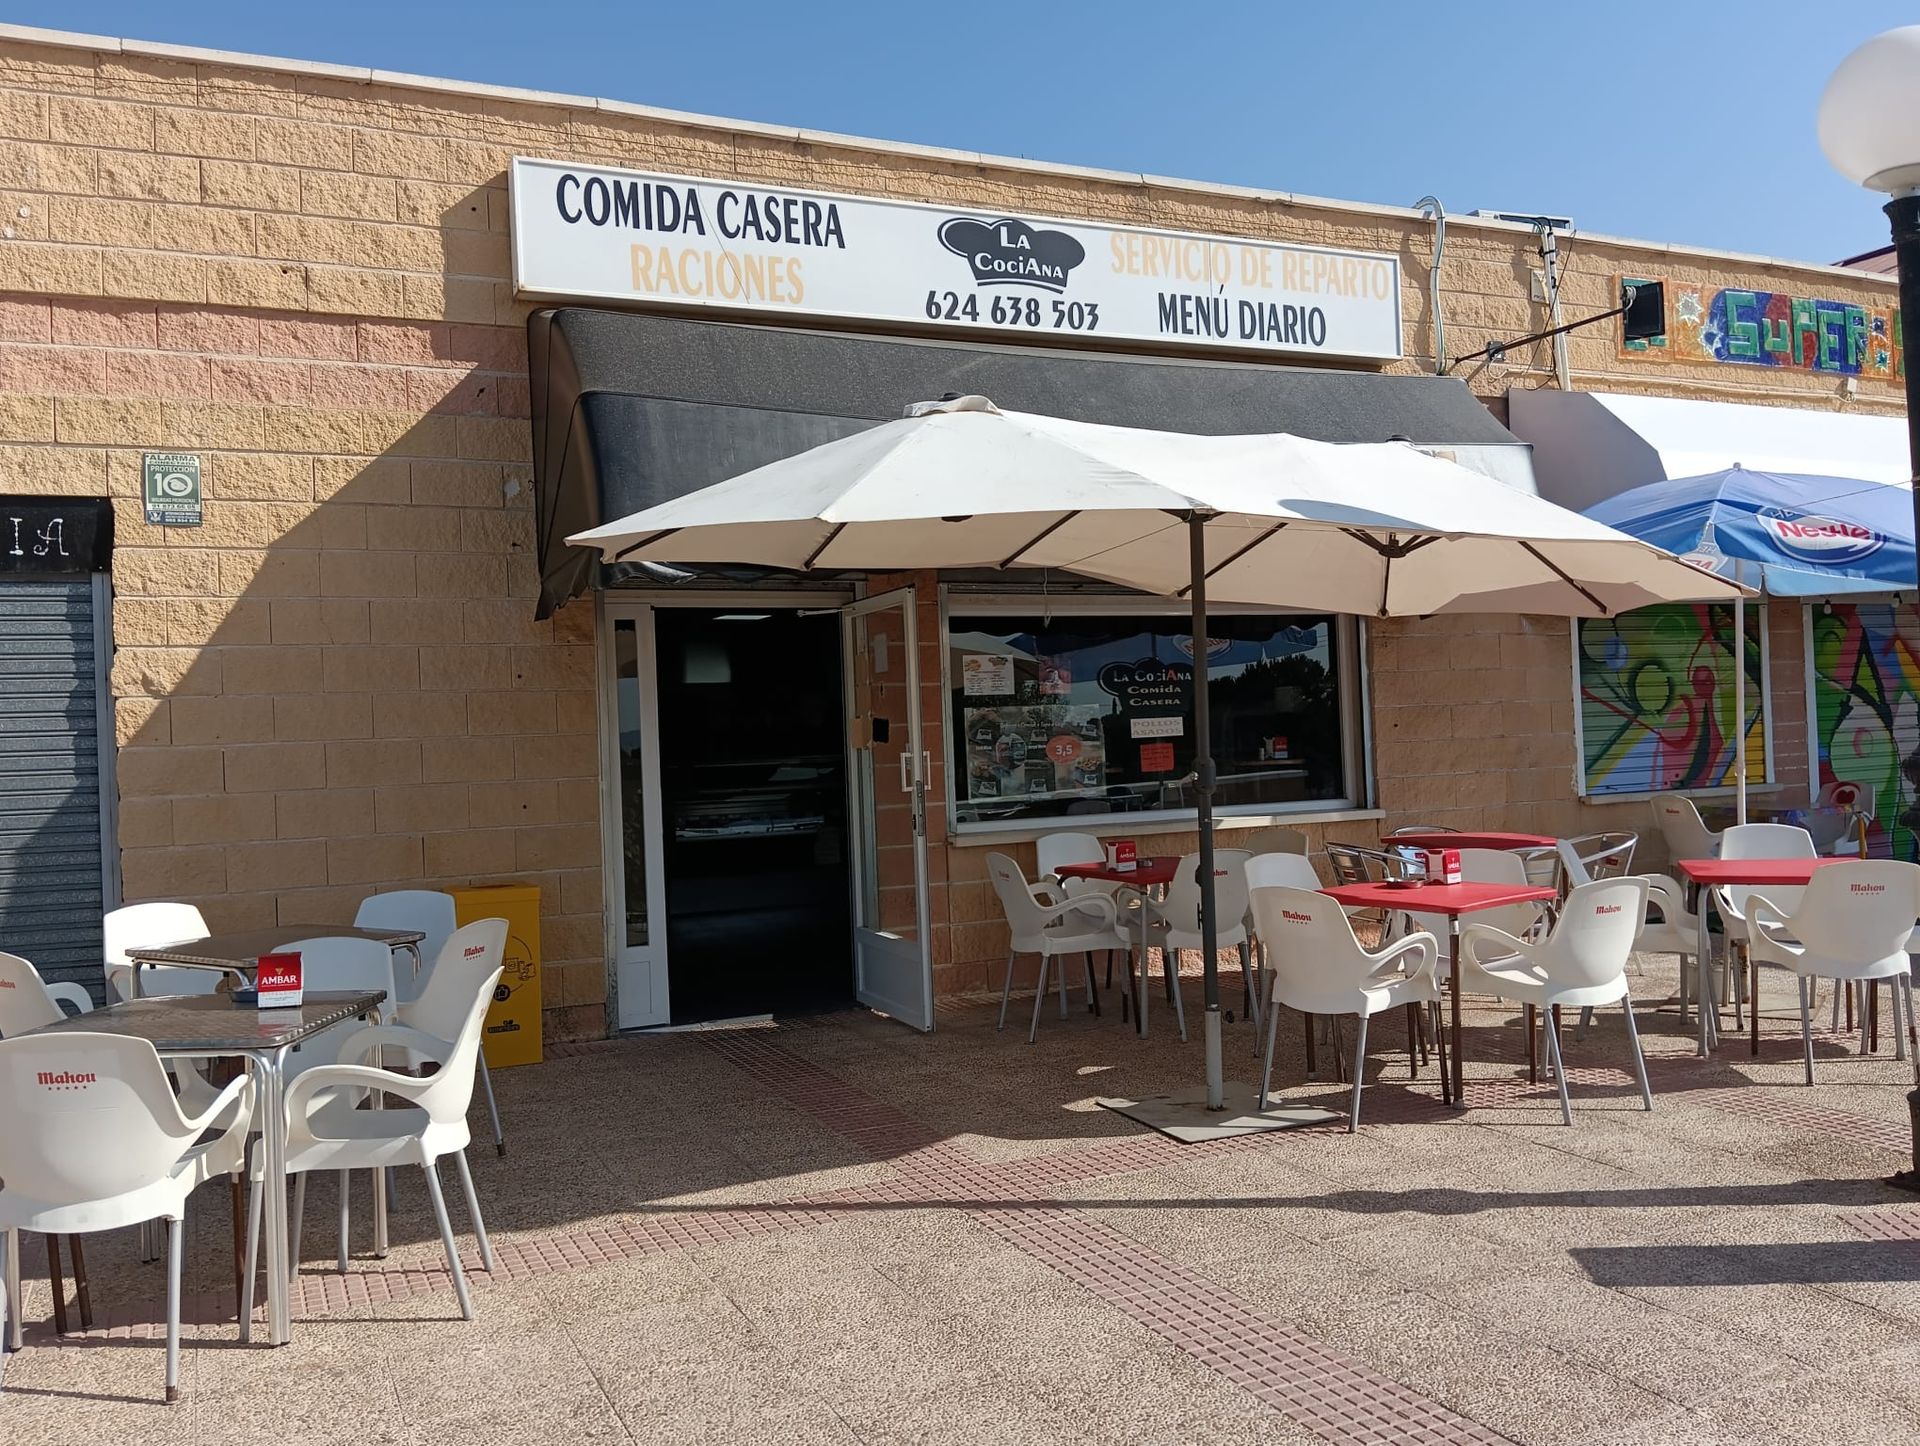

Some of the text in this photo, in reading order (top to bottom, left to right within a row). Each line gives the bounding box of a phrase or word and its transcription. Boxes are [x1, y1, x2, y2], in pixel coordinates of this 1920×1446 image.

[556, 174, 846, 249] COMIDA CASERA
[1110, 232, 1390, 301] SERVICIO DE REPARTO
[630, 244, 805, 305] RACIONES
[925, 290, 1100, 331] 624 638 503
[1158, 284, 1327, 347] MENÚ DIARIO
[153, 473, 193, 497] 10
[1133, 719, 1182, 728] POLLOS
[1133, 727, 1183, 737] ASADOS
[1851, 883, 1885, 892] Mahou
[1281, 910, 1312, 921] Mahou
[1595, 904, 1622, 915] Mahou
[463, 945, 485, 958] Mahou
[261, 974, 297, 985] AMBAR
[36, 1071, 97, 1085] Mahou
